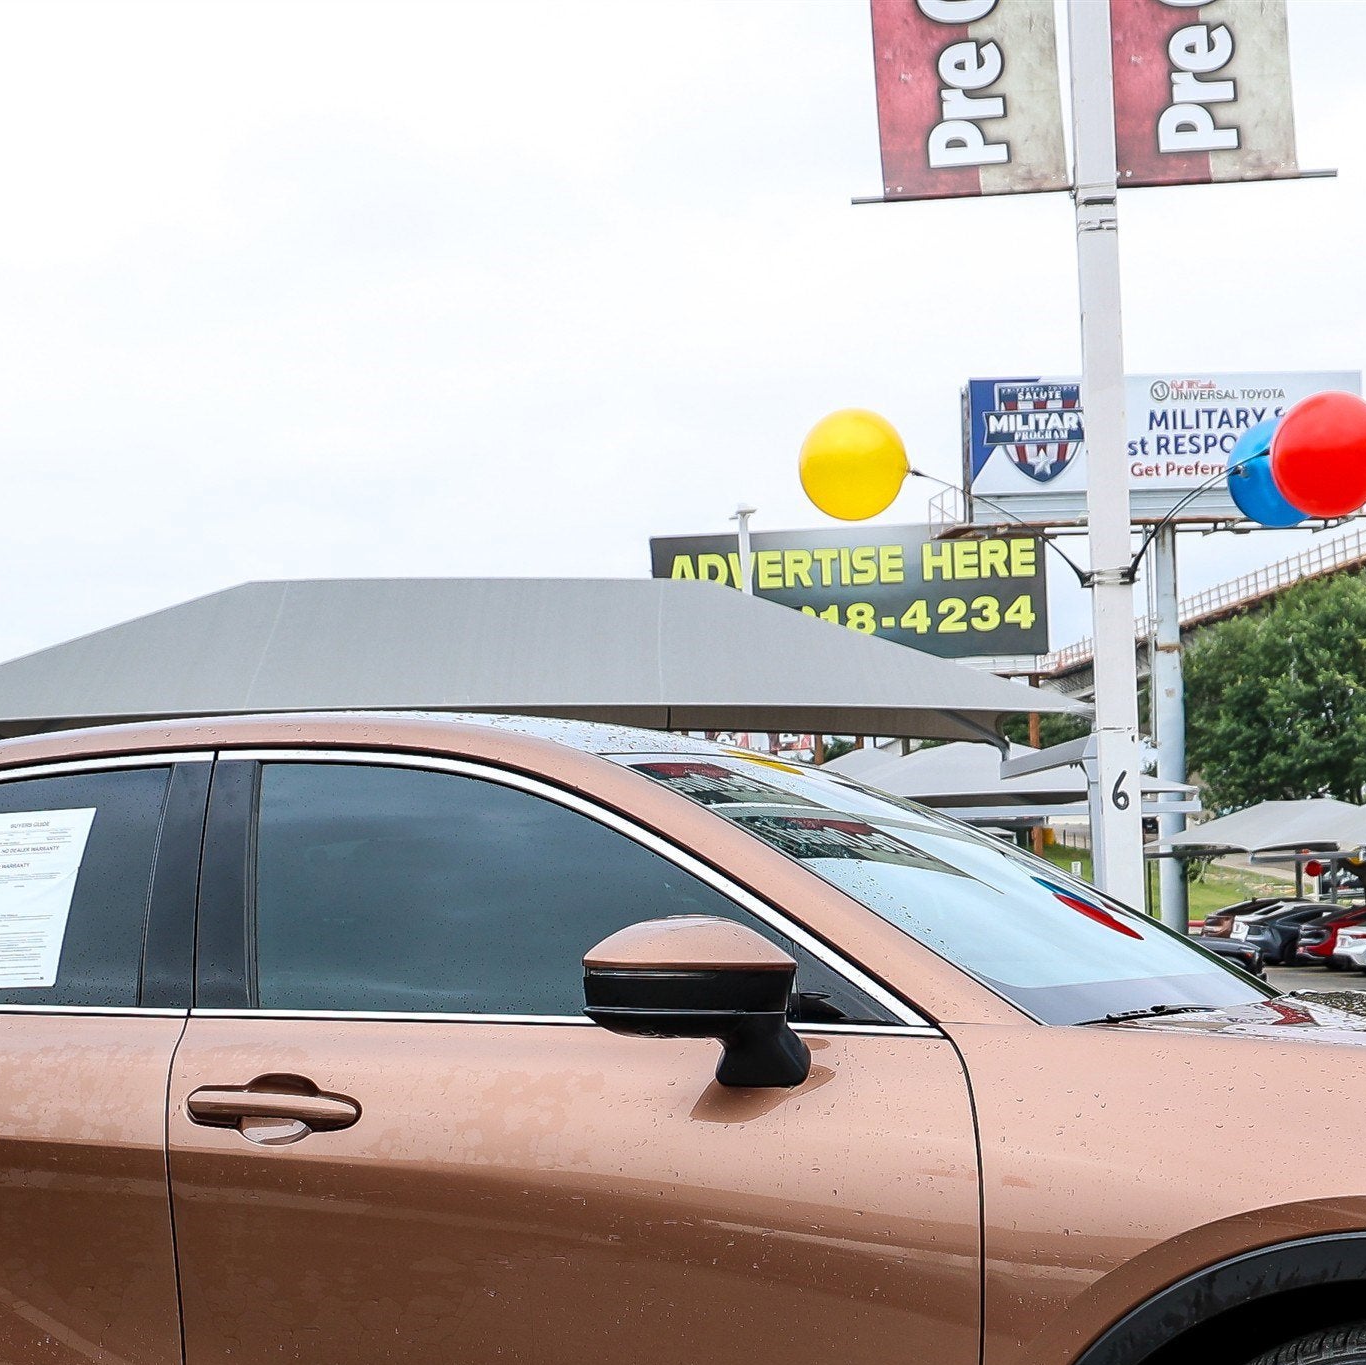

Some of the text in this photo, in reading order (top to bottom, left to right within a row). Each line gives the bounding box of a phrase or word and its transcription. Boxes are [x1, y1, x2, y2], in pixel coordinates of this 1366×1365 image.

[1158, 25, 1240, 153] Pre
[928, 40, 1010, 168] Pre
[1017, 391, 1062, 400] SALUTE
[1171, 388, 1285, 400] UNIVERSAL TOYOTA
[1014, 430, 1068, 440] PROGRAM
[1131, 462, 1161, 477] Get
[671, 537, 1036, 590] ADVERTISE HERE
[1111, 770, 1130, 811] 6
